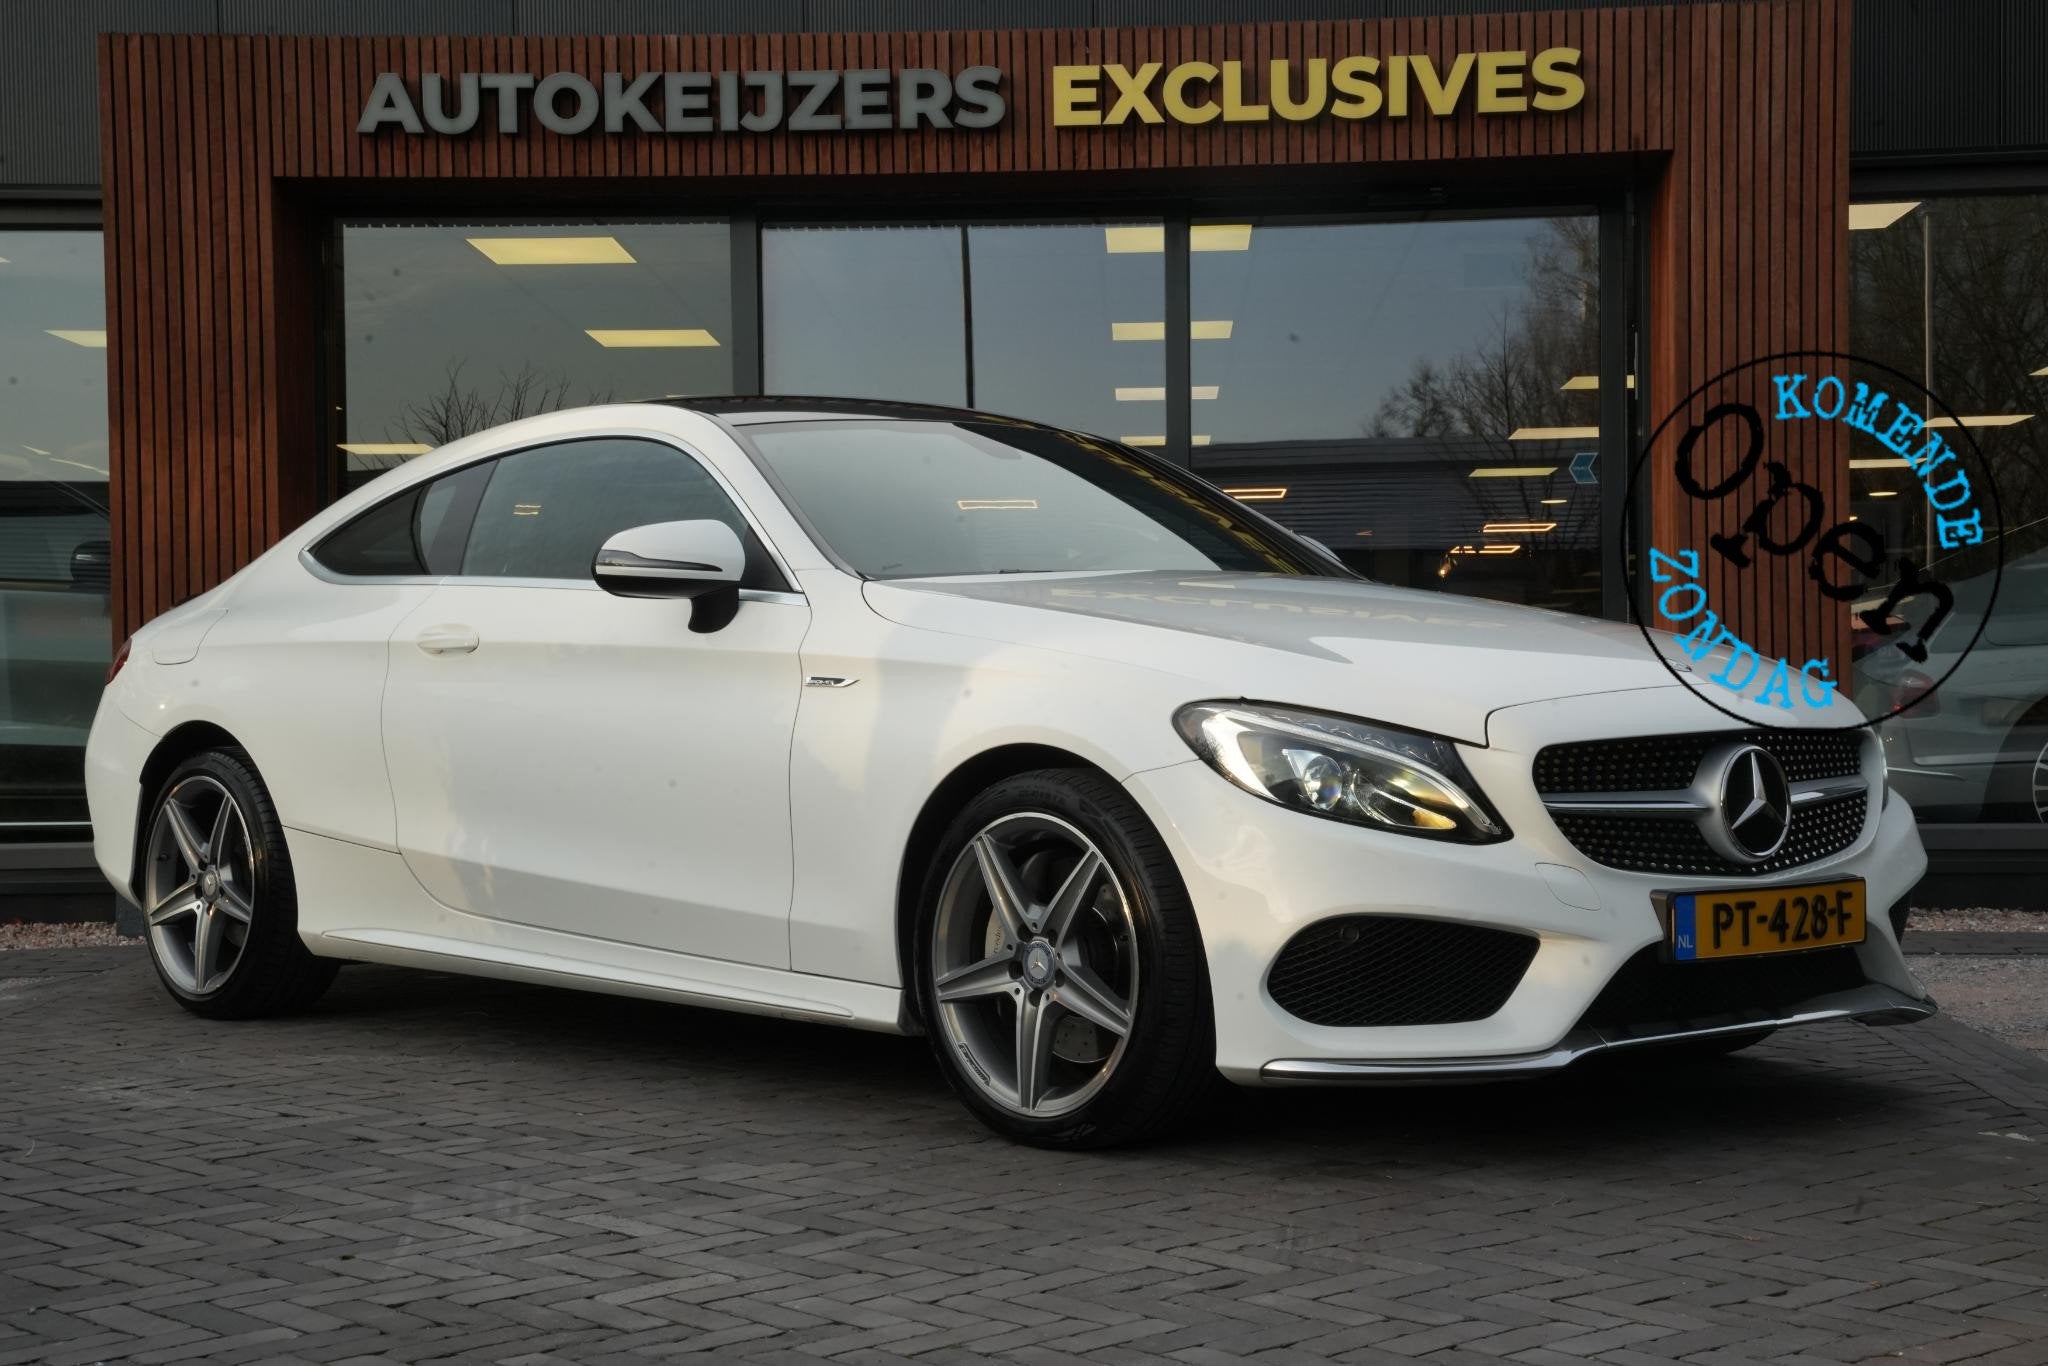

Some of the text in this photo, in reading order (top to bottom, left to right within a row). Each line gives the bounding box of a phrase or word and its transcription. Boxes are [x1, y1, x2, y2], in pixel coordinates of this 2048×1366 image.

[356, 47, 1587, 135] AUTOKEIJZERS EXCLUSIVES
[1678, 890, 1853, 950] NL PT-428-F
